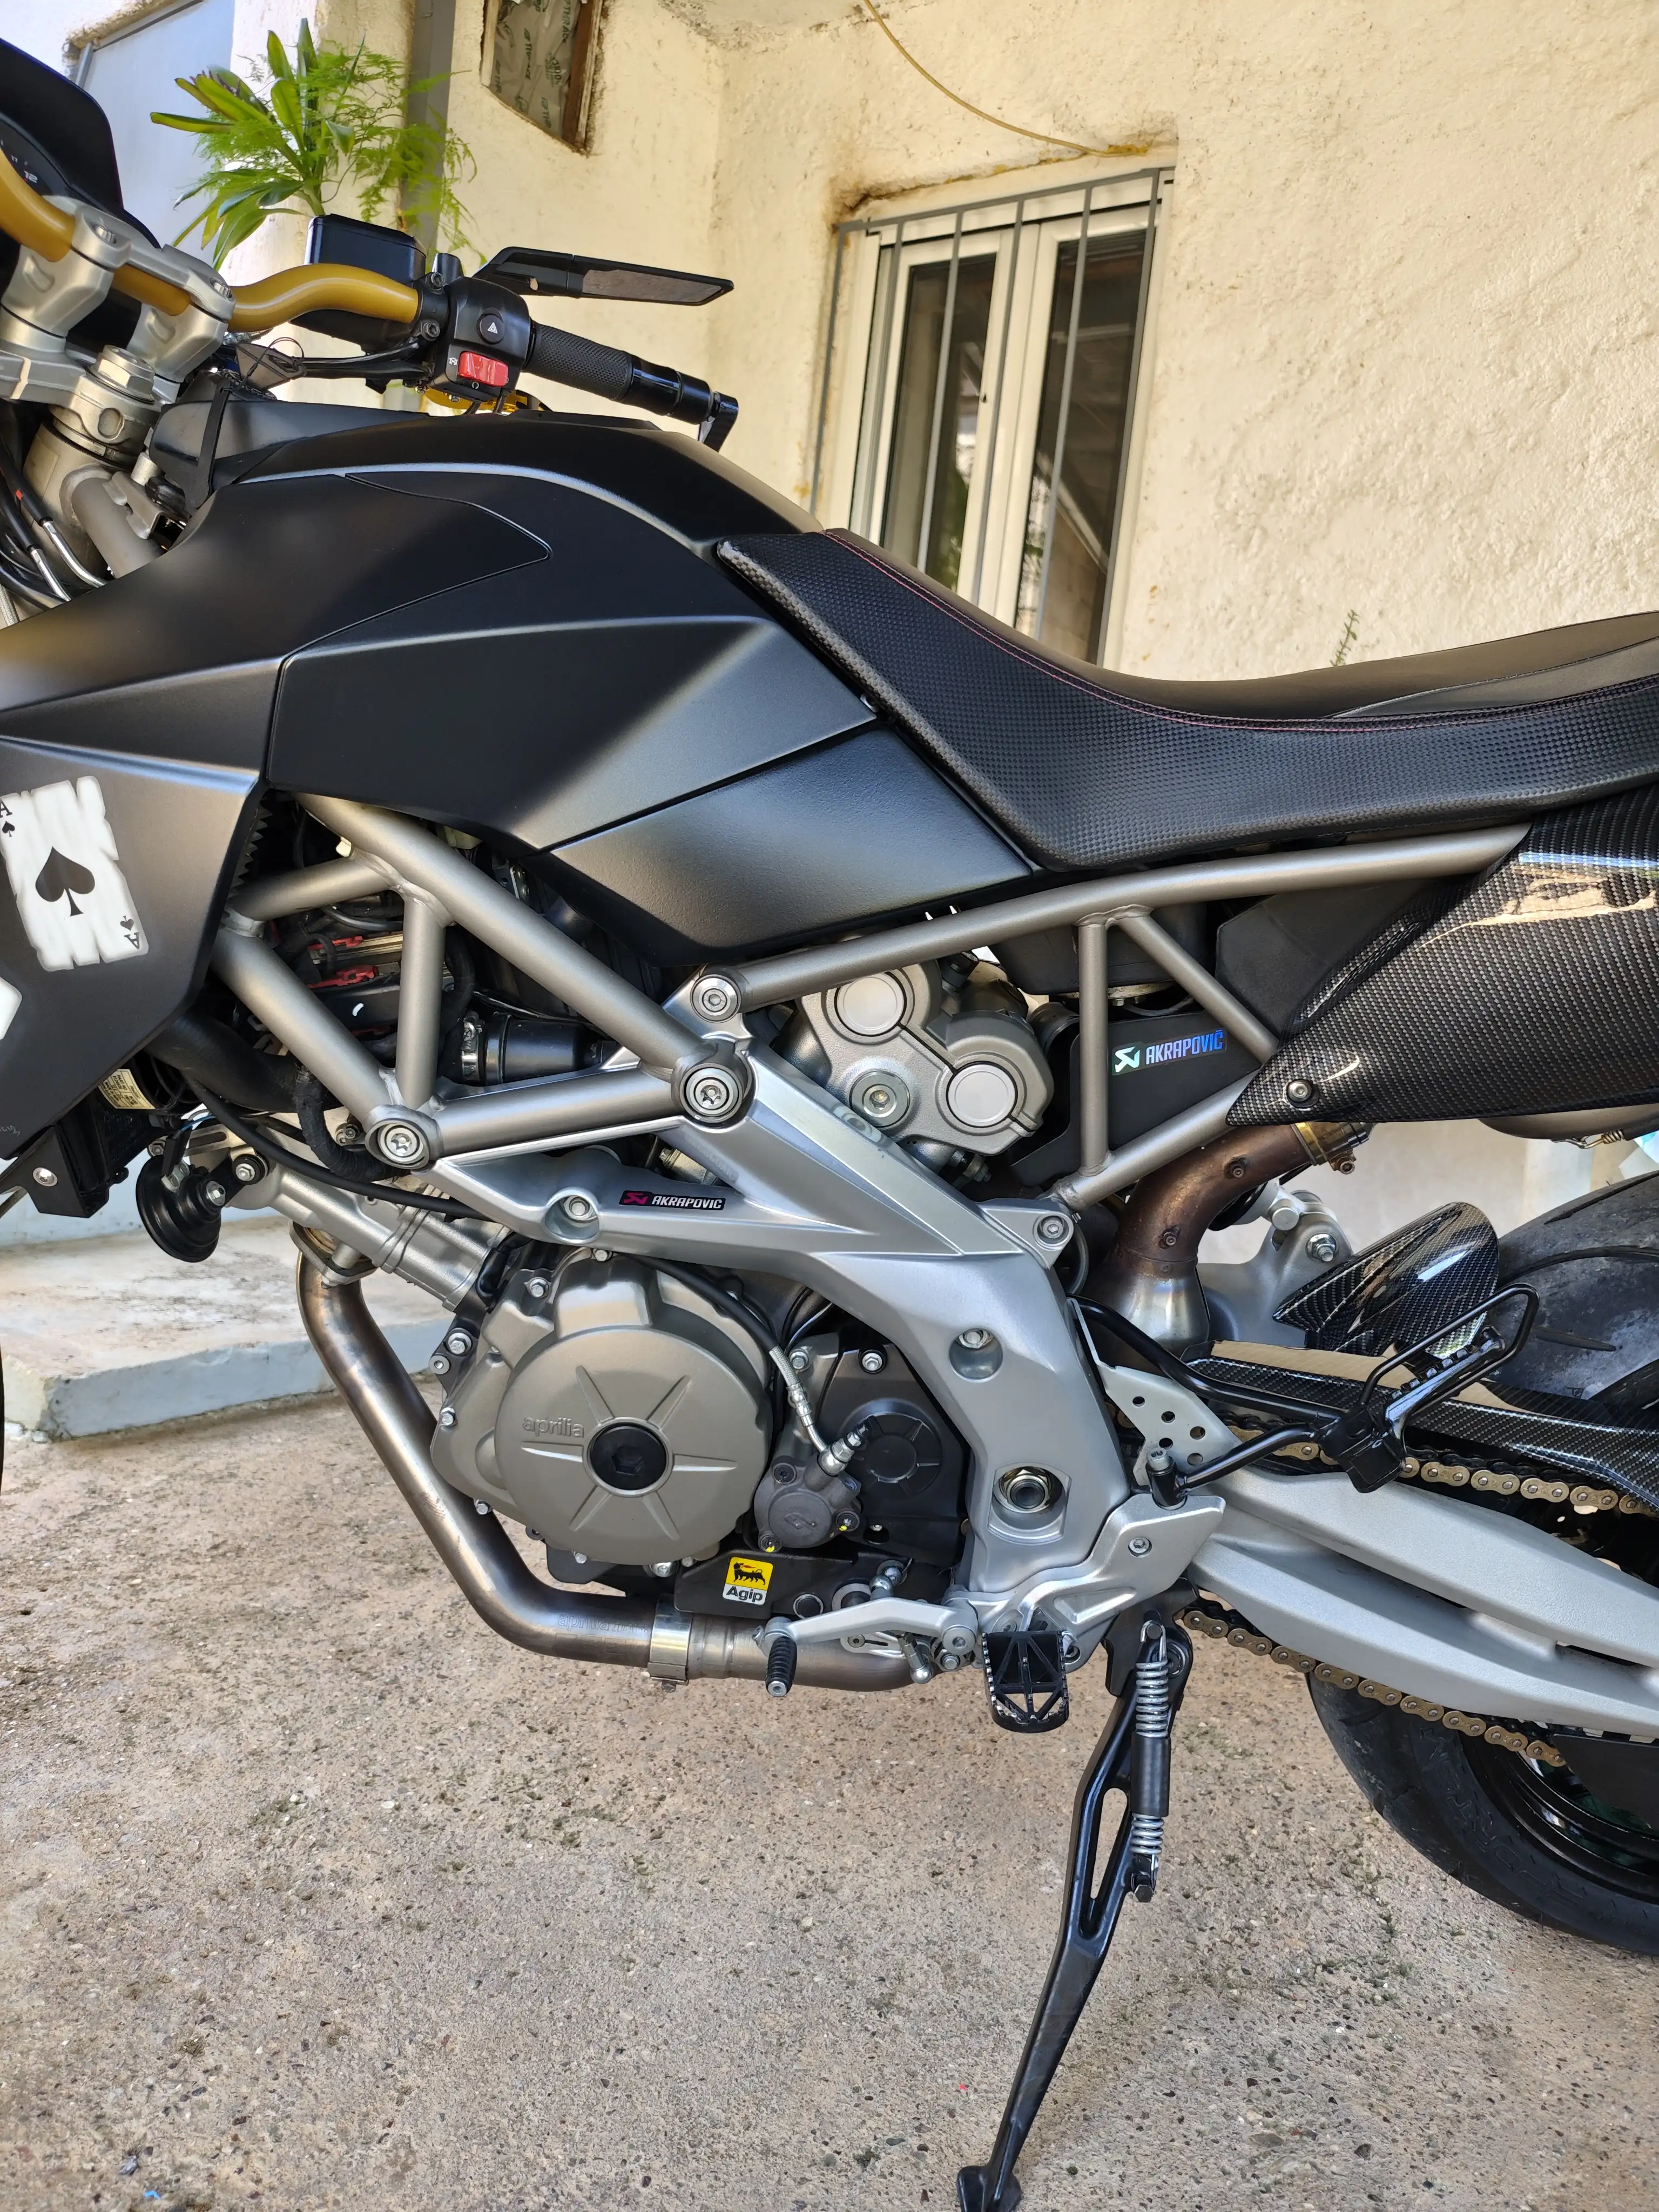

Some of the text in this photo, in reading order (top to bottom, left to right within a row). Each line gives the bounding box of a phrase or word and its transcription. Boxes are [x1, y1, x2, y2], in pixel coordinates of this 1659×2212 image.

[24, 170, 38, 184] 12
[0, 798, 12, 818] A
[124, 932, 140, 949] A
[522, 1416, 584, 1438] aprilia
[726, 1586, 763, 1602] Agip
[558, 1613, 609, 1631] aprilia
